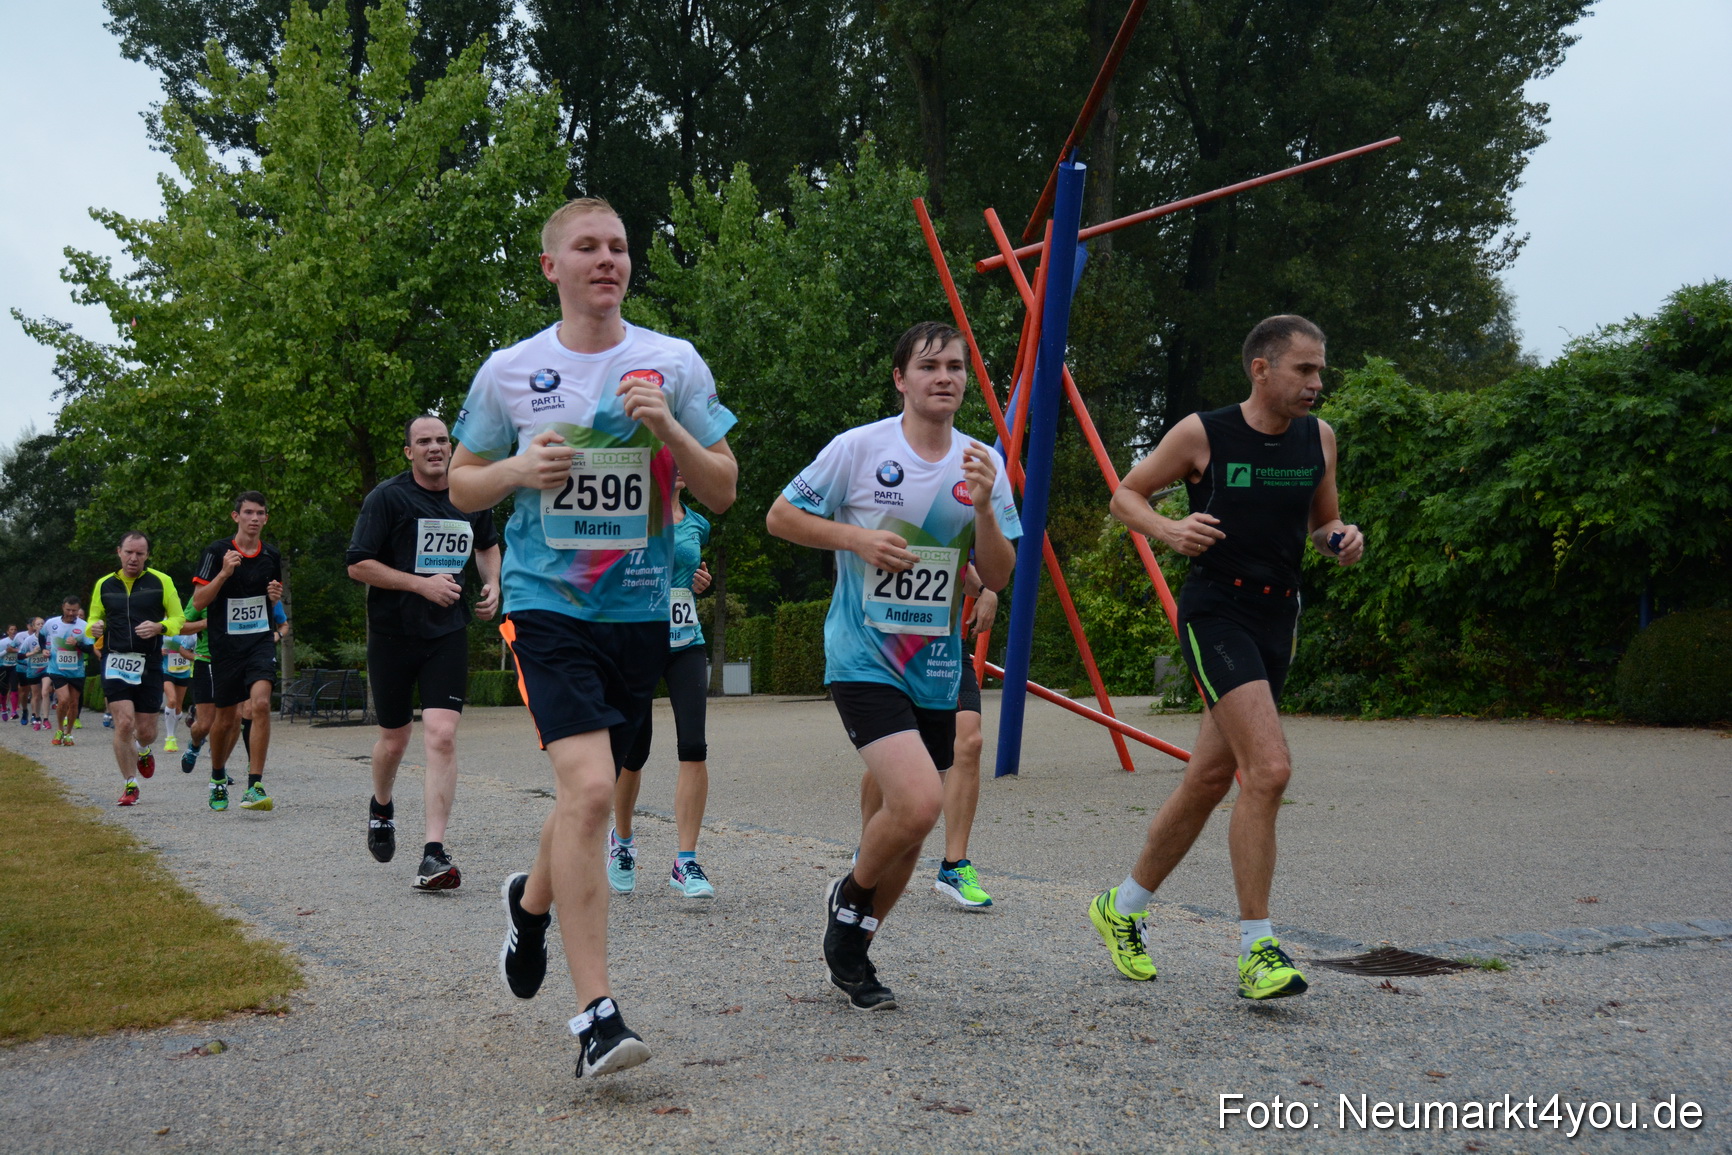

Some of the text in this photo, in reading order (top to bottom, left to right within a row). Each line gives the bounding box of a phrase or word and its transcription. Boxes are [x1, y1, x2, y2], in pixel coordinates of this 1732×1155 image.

[531, 395, 565, 407] PARTL
[533, 403, 565, 413] Neumarkt
[592, 452, 643, 464] BOCK
[553, 473, 642, 512] 2596
[793, 474, 824, 507] BOCK
[874, 490, 904, 501] PARTL
[874, 498, 904, 507] Neumarkt
[574, 519, 621, 536] Martin
[424, 532, 469, 553] 2756
[424, 557, 464, 567] Christopher
[629, 549, 645, 565] 17.
[873, 567, 949, 602] 2622
[232, 604, 264, 621] 2557
[885, 607, 933, 624] Andreas
[930, 642, 948, 658] 17.
[58, 655, 77, 663] 3031
[111, 657, 142, 673] 2052
